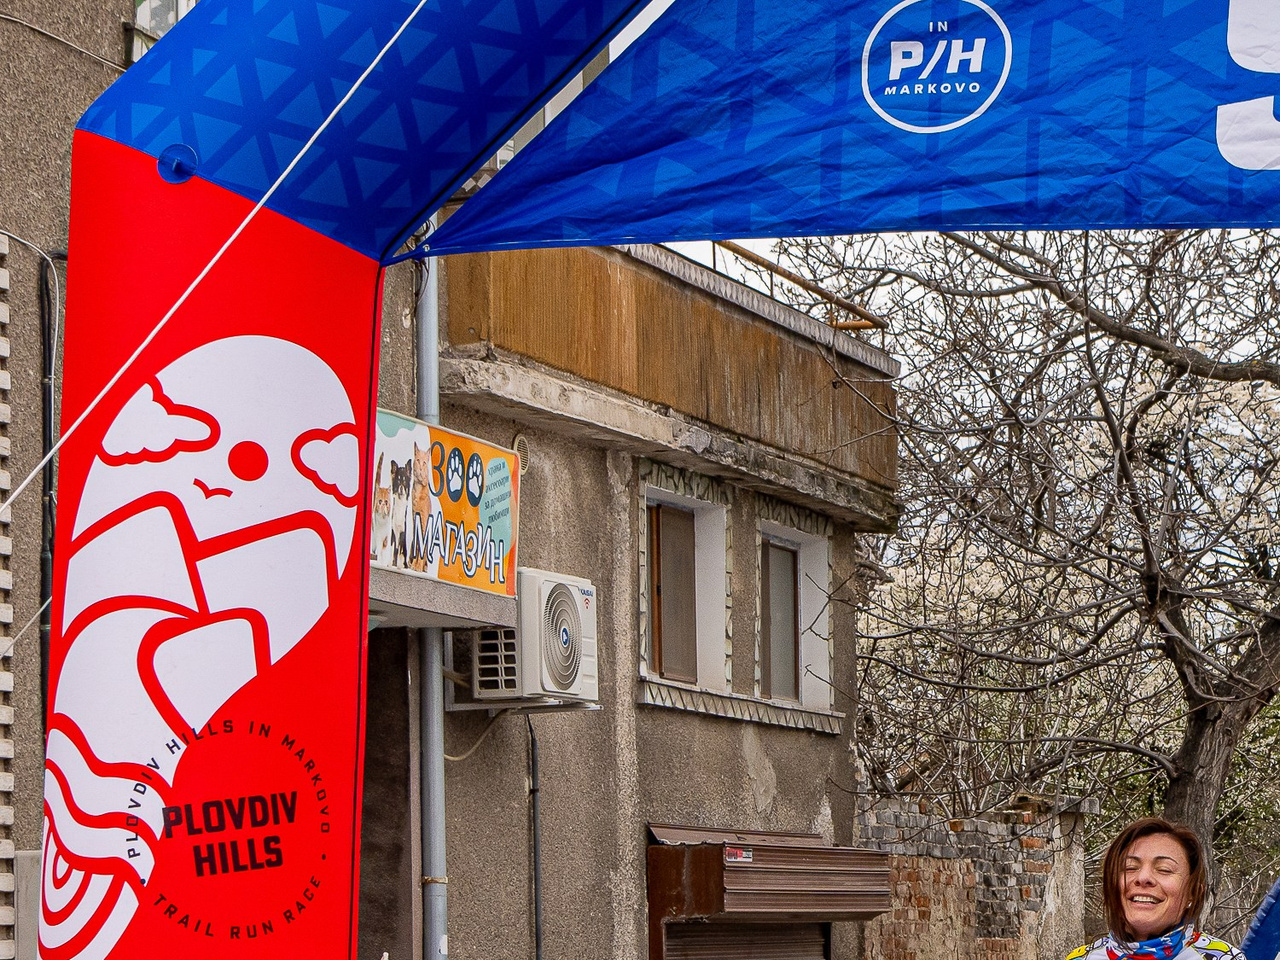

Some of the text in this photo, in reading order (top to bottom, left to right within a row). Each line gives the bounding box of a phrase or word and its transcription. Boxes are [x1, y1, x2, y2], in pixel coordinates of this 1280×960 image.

[929, 21, 949, 32] IN
[888, 38, 987, 81] P/H
[884, 82, 981, 96] MARKOVO
[413, 511, 505, 584] МАГАЗИН
[126, 720, 330, 859] PLOVDIV HILLS IN MARKOVO
[162, 791, 298, 839] PLOVDIV
[193, 835, 284, 878] HILLS
[153, 875, 321, 940] TRAIL RUN RACE
